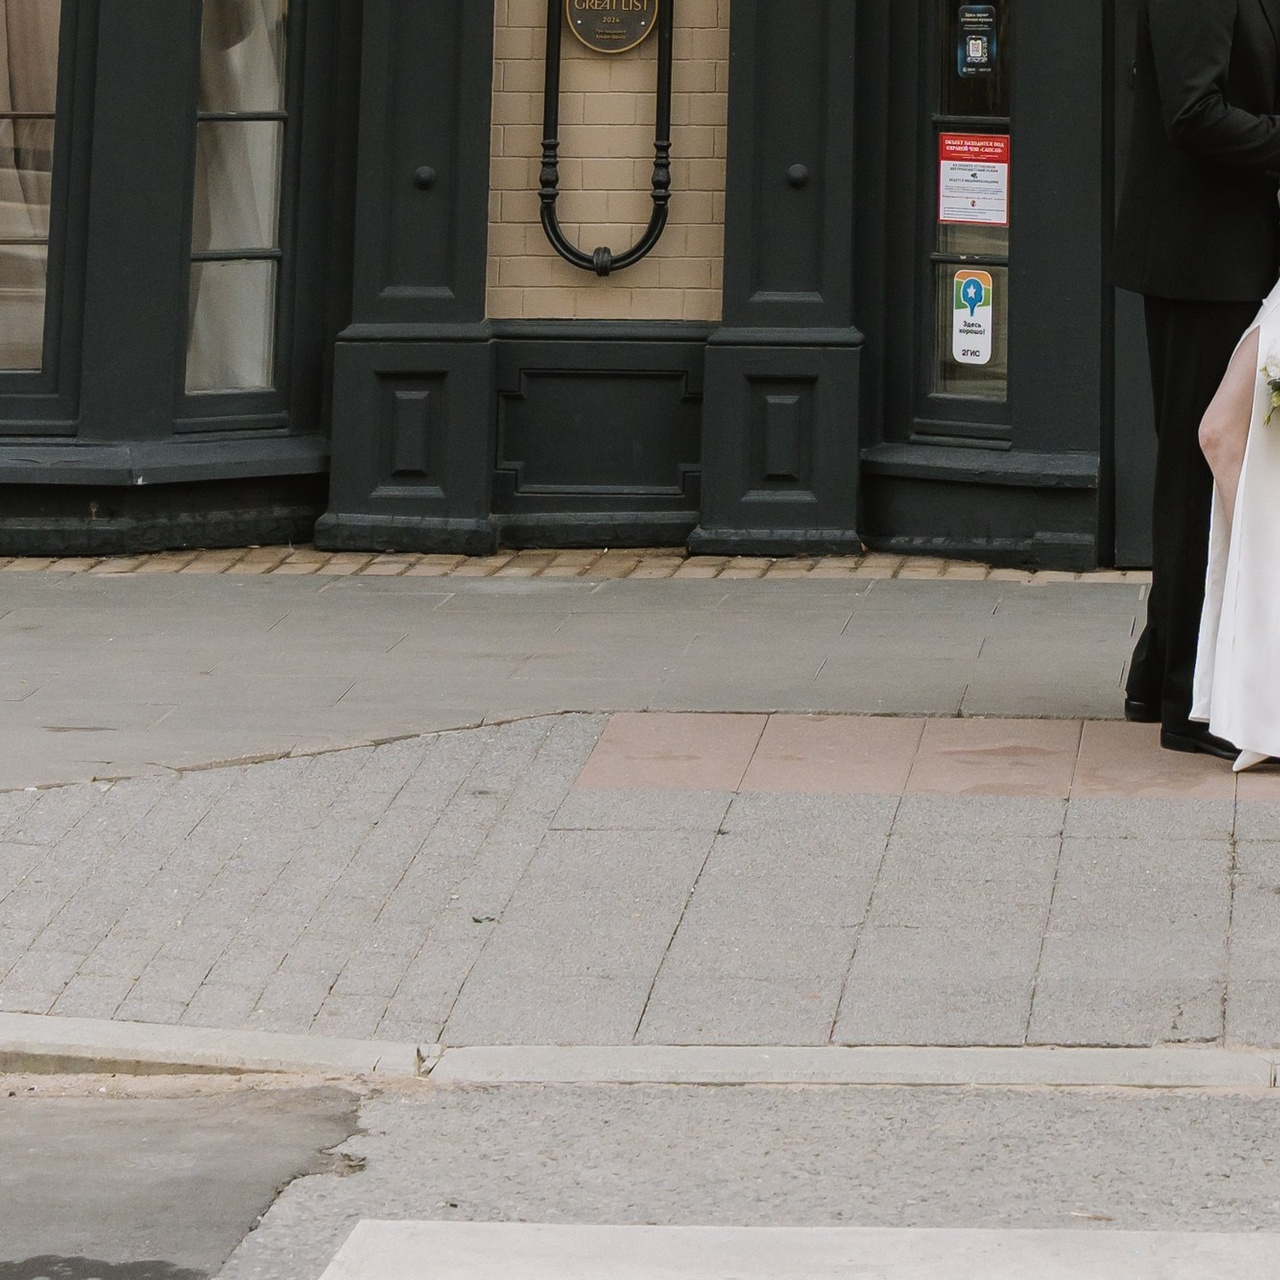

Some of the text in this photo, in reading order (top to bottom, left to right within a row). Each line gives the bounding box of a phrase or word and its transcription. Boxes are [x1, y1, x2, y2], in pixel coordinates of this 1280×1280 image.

[963, 320, 982, 328] Здесь
[959, 328, 986, 336] хорошо!
[961, 349, 981, 357] 2ГИС
